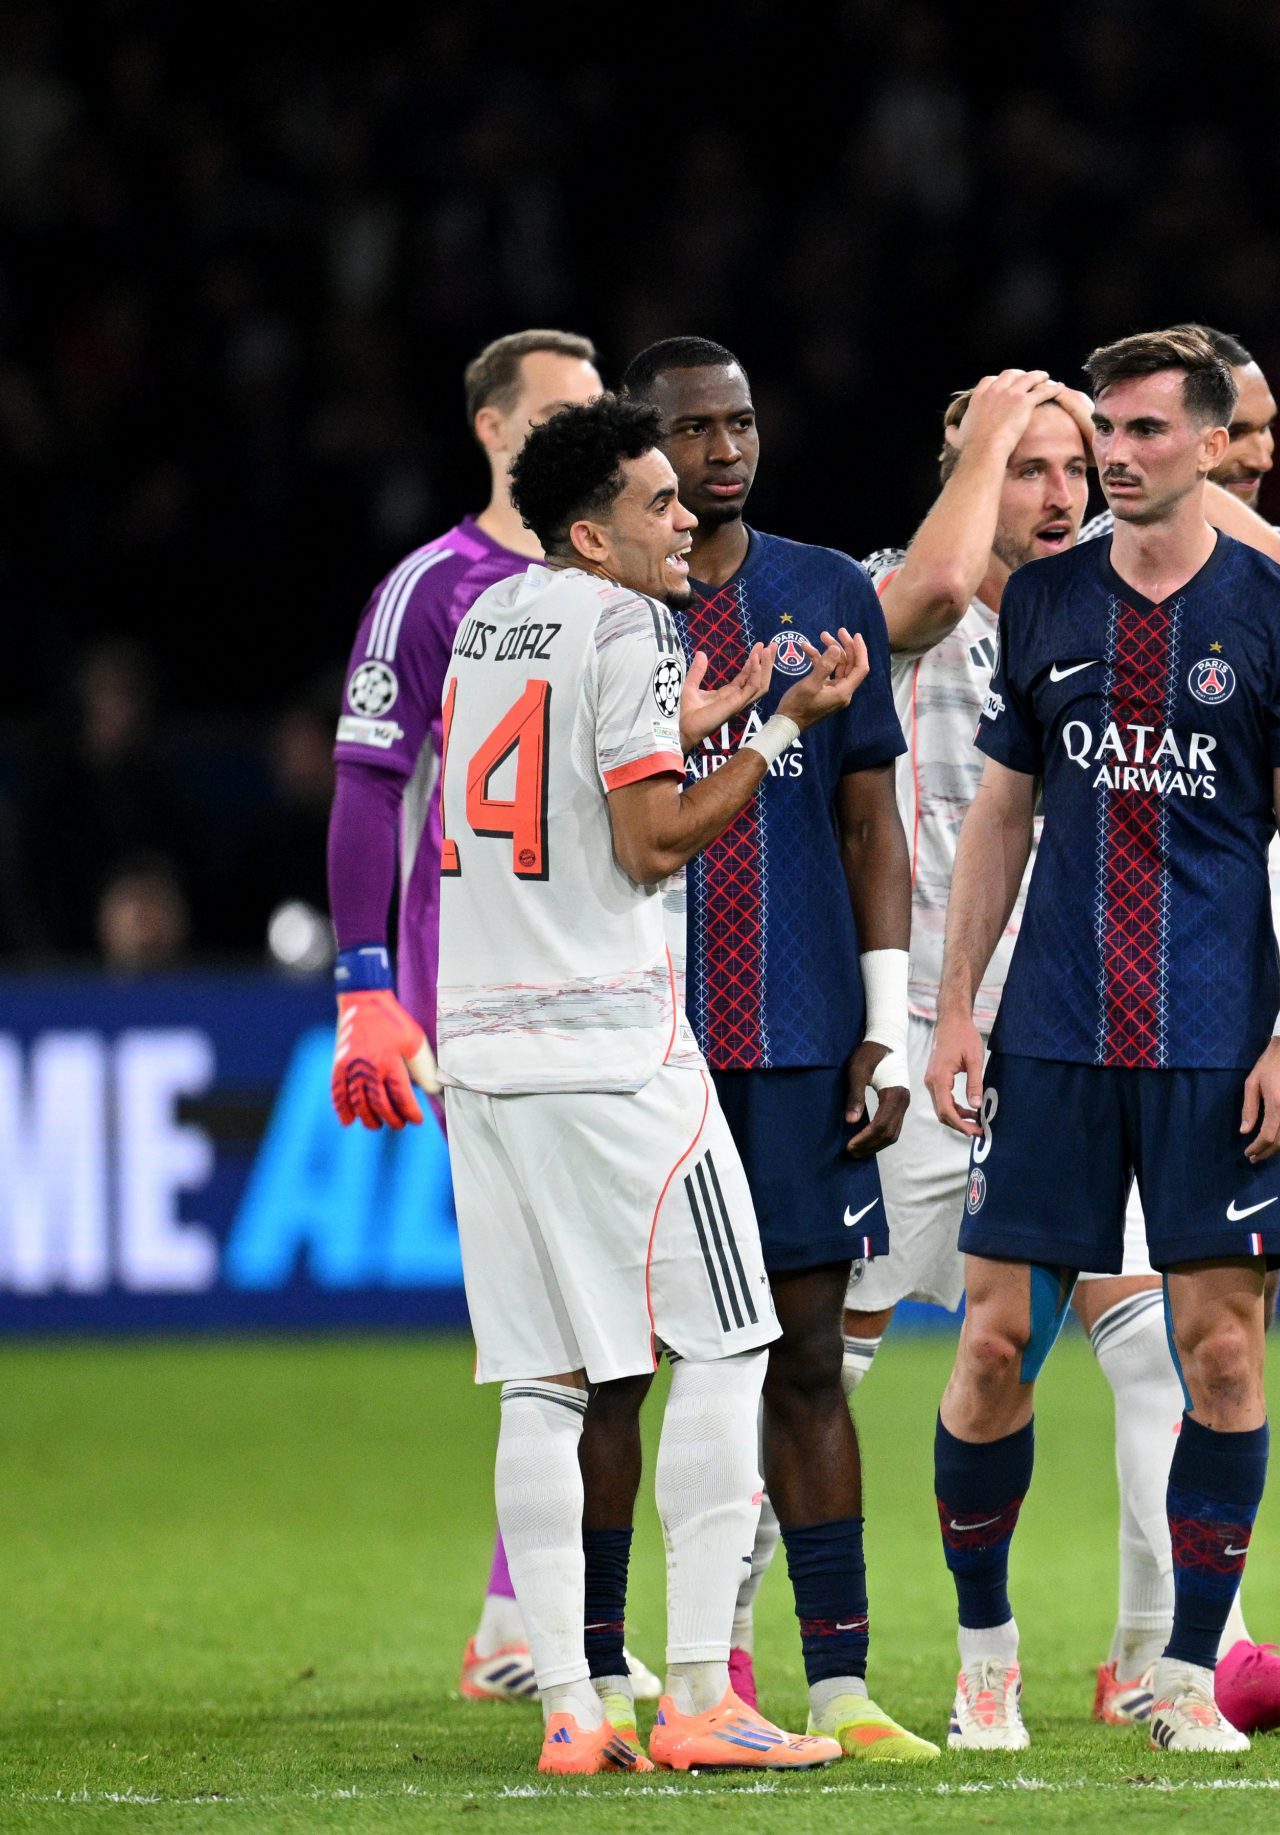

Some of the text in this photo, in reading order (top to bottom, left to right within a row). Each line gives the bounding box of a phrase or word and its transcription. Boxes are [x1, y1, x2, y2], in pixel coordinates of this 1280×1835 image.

[495, 617, 562, 661] DÍAZ
[1198, 661, 1228, 673] PARIS
[1062, 721, 1217, 771] QATAR
[1093, 765, 1217, 799] AIRWAYS
